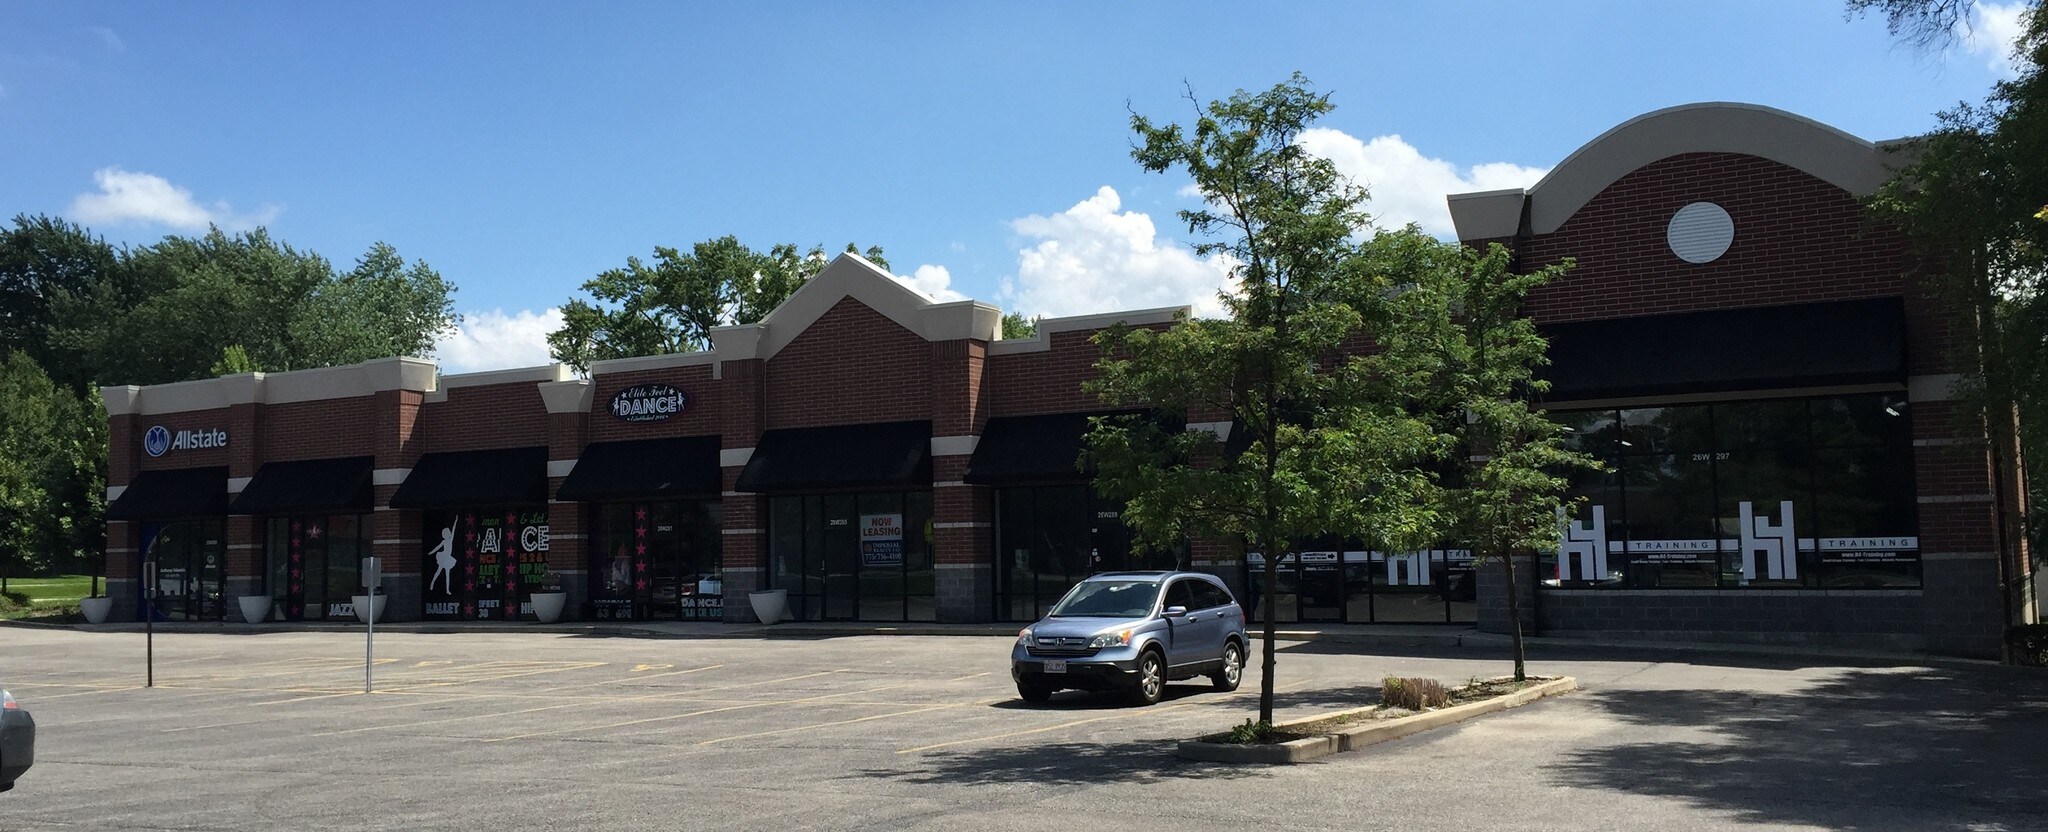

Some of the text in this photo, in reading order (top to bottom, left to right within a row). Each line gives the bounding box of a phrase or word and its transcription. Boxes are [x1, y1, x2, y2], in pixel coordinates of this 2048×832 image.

[619, 396, 677, 416] DANCE
[171, 428, 227, 450] Allstate
[1692, 452, 1730, 461] 26W 297
[872, 517, 892, 526] NOW
[863, 527, 901, 536] LEASING
[1827, 539, 1908, 547] TRAINING
[425, 602, 460, 614] BALLET
